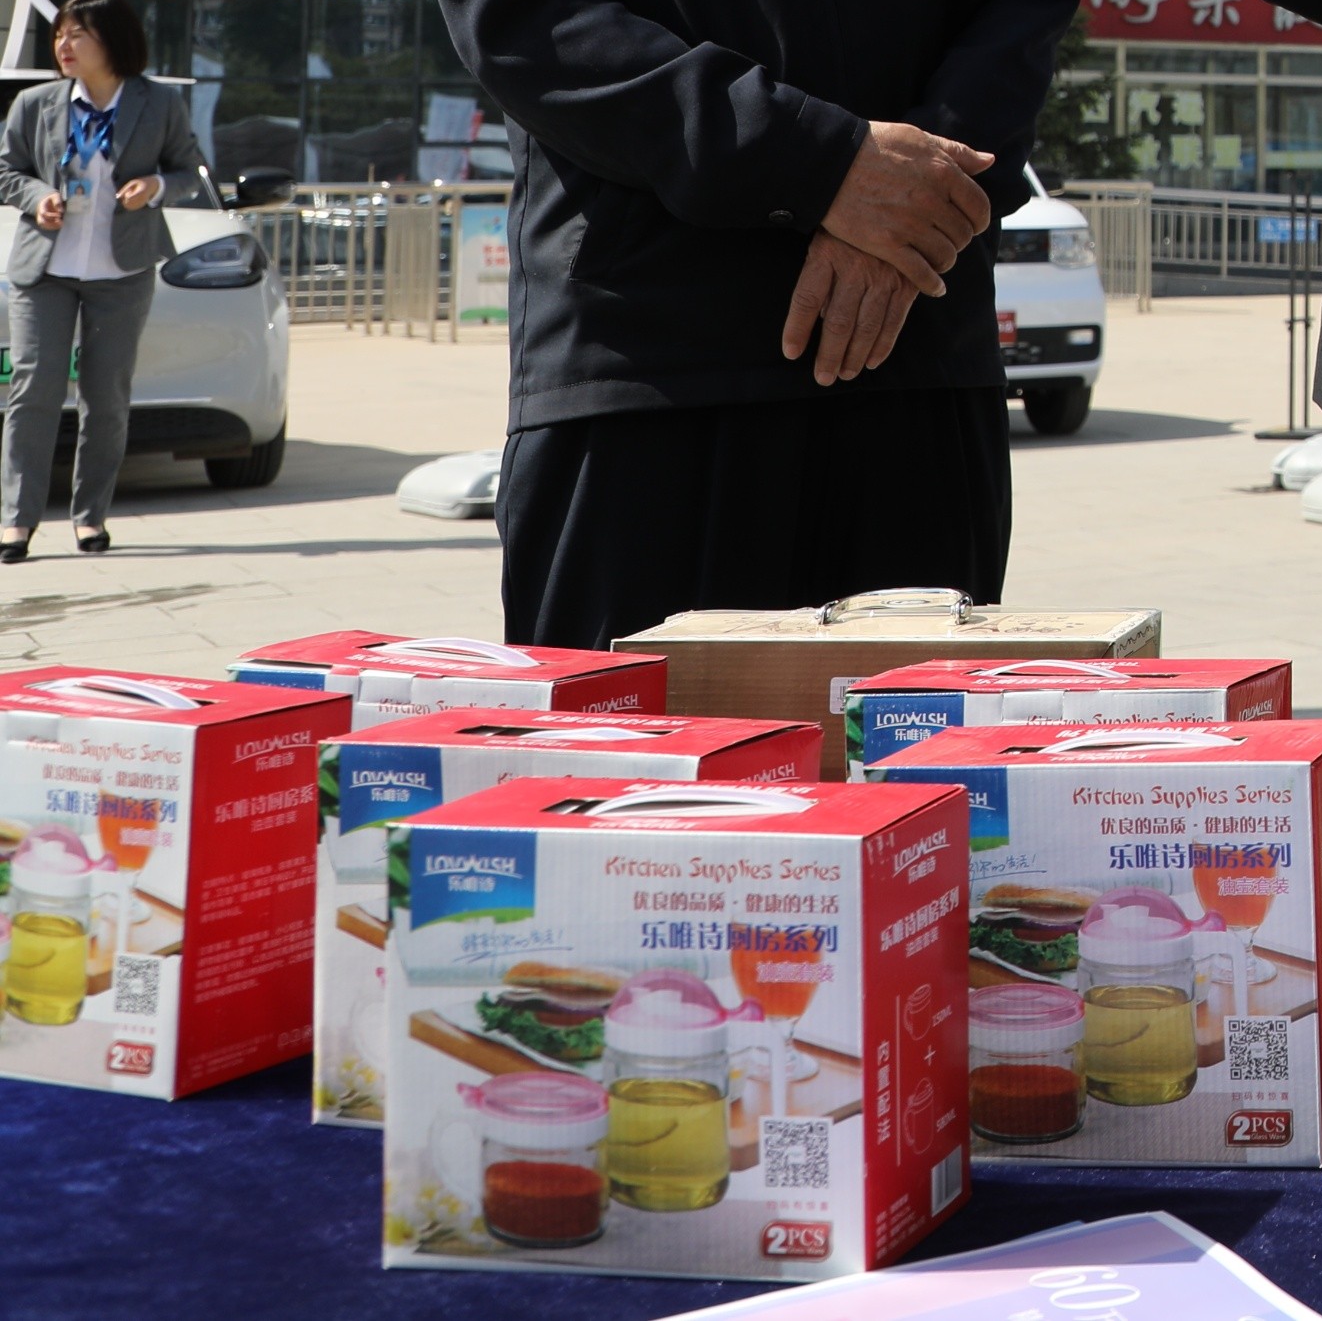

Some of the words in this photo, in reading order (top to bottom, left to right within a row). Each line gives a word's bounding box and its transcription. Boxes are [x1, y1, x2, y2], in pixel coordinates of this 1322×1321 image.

[1072, 785, 1145, 806] Kitchen
[1151, 785, 1229, 810] Supplies
[1235, 784, 1293, 805] Series
[605, 856, 682, 880] Kitchen
[688, 856, 773, 885] Supplies
[778, 858, 842, 883] Series
[1108, 842, 1293, 871] 乐唯诗厨房系列
[640, 921, 840, 955] 乐唯诗厨房系列
